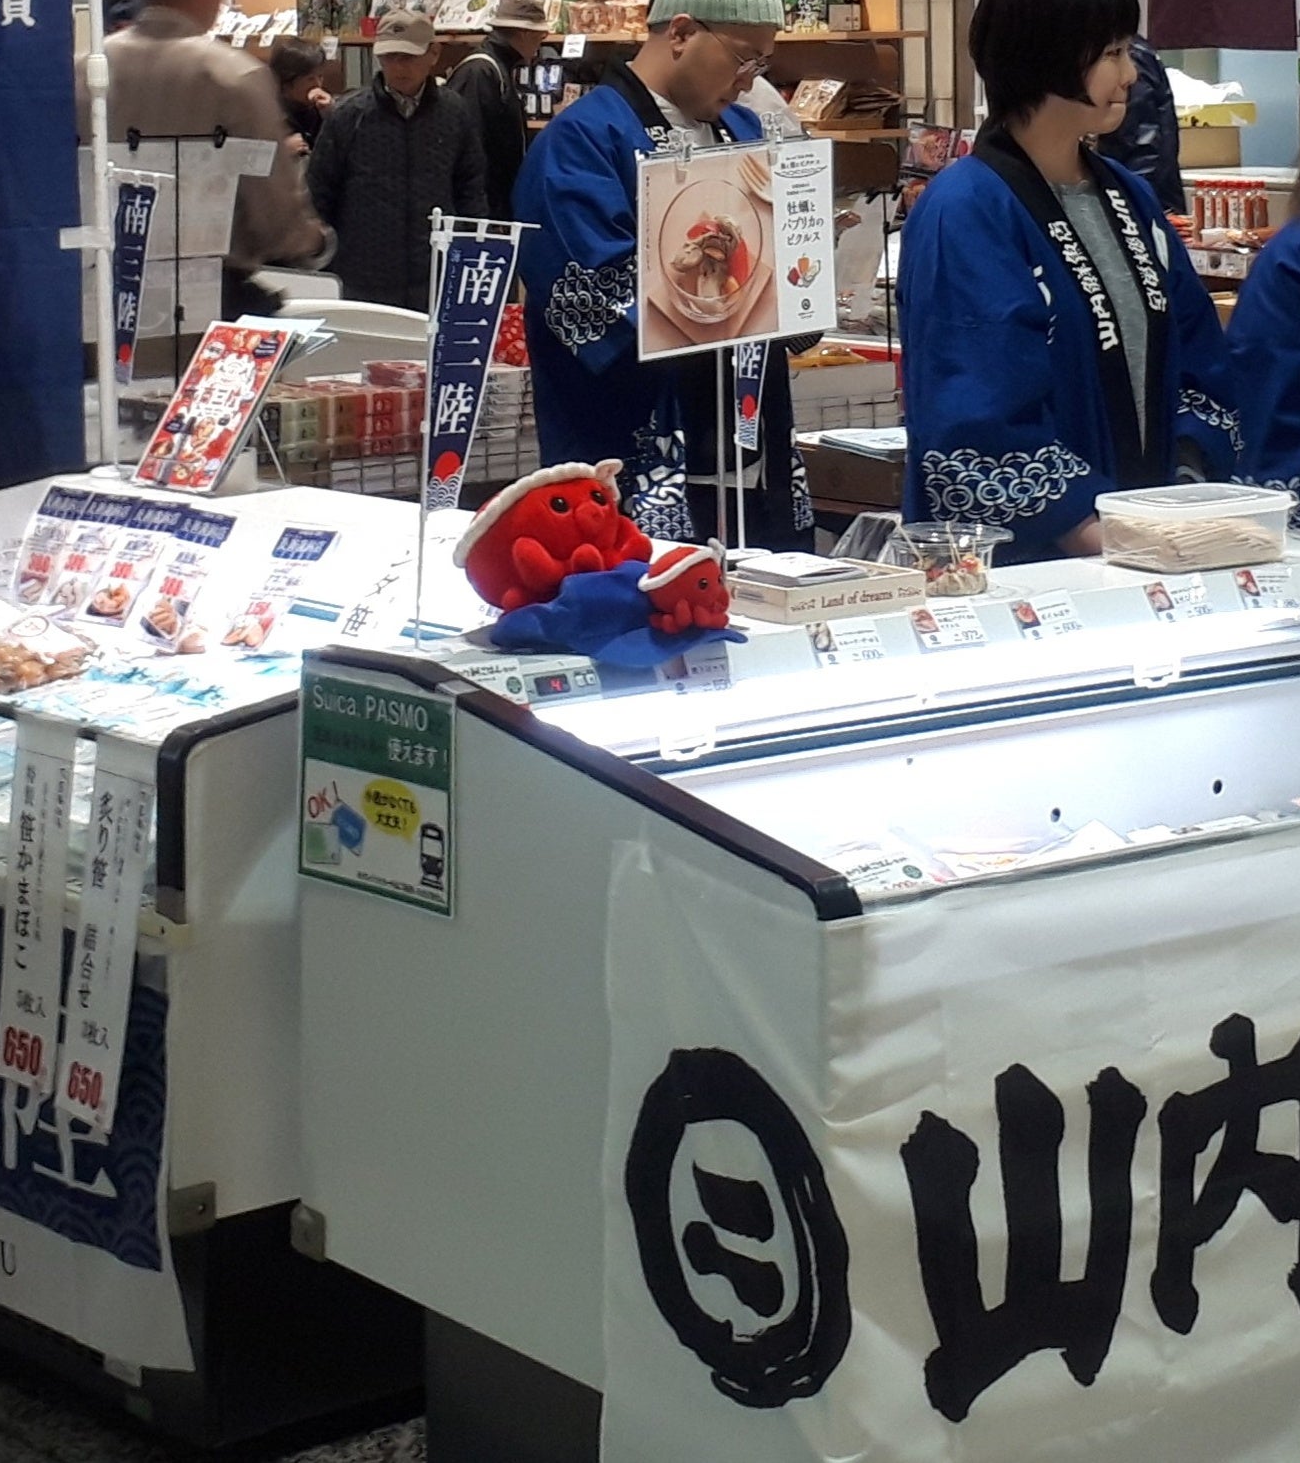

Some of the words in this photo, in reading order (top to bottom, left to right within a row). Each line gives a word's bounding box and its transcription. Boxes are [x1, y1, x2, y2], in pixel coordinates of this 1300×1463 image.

[782, 217, 825, 232] パプリカの
[787, 231, 821, 246] ピクルス
[117, 194, 152, 332] 南三陸
[433, 250, 508, 438] 南三陸
[821, 595, 844, 610] Land
[846, 593, 858, 605] of
[859, 589, 894, 604] dreams
[365, 694, 429, 732] PASMO
[3, 1026, 42, 1076] 650
[67, 1061, 103, 1110] 650
